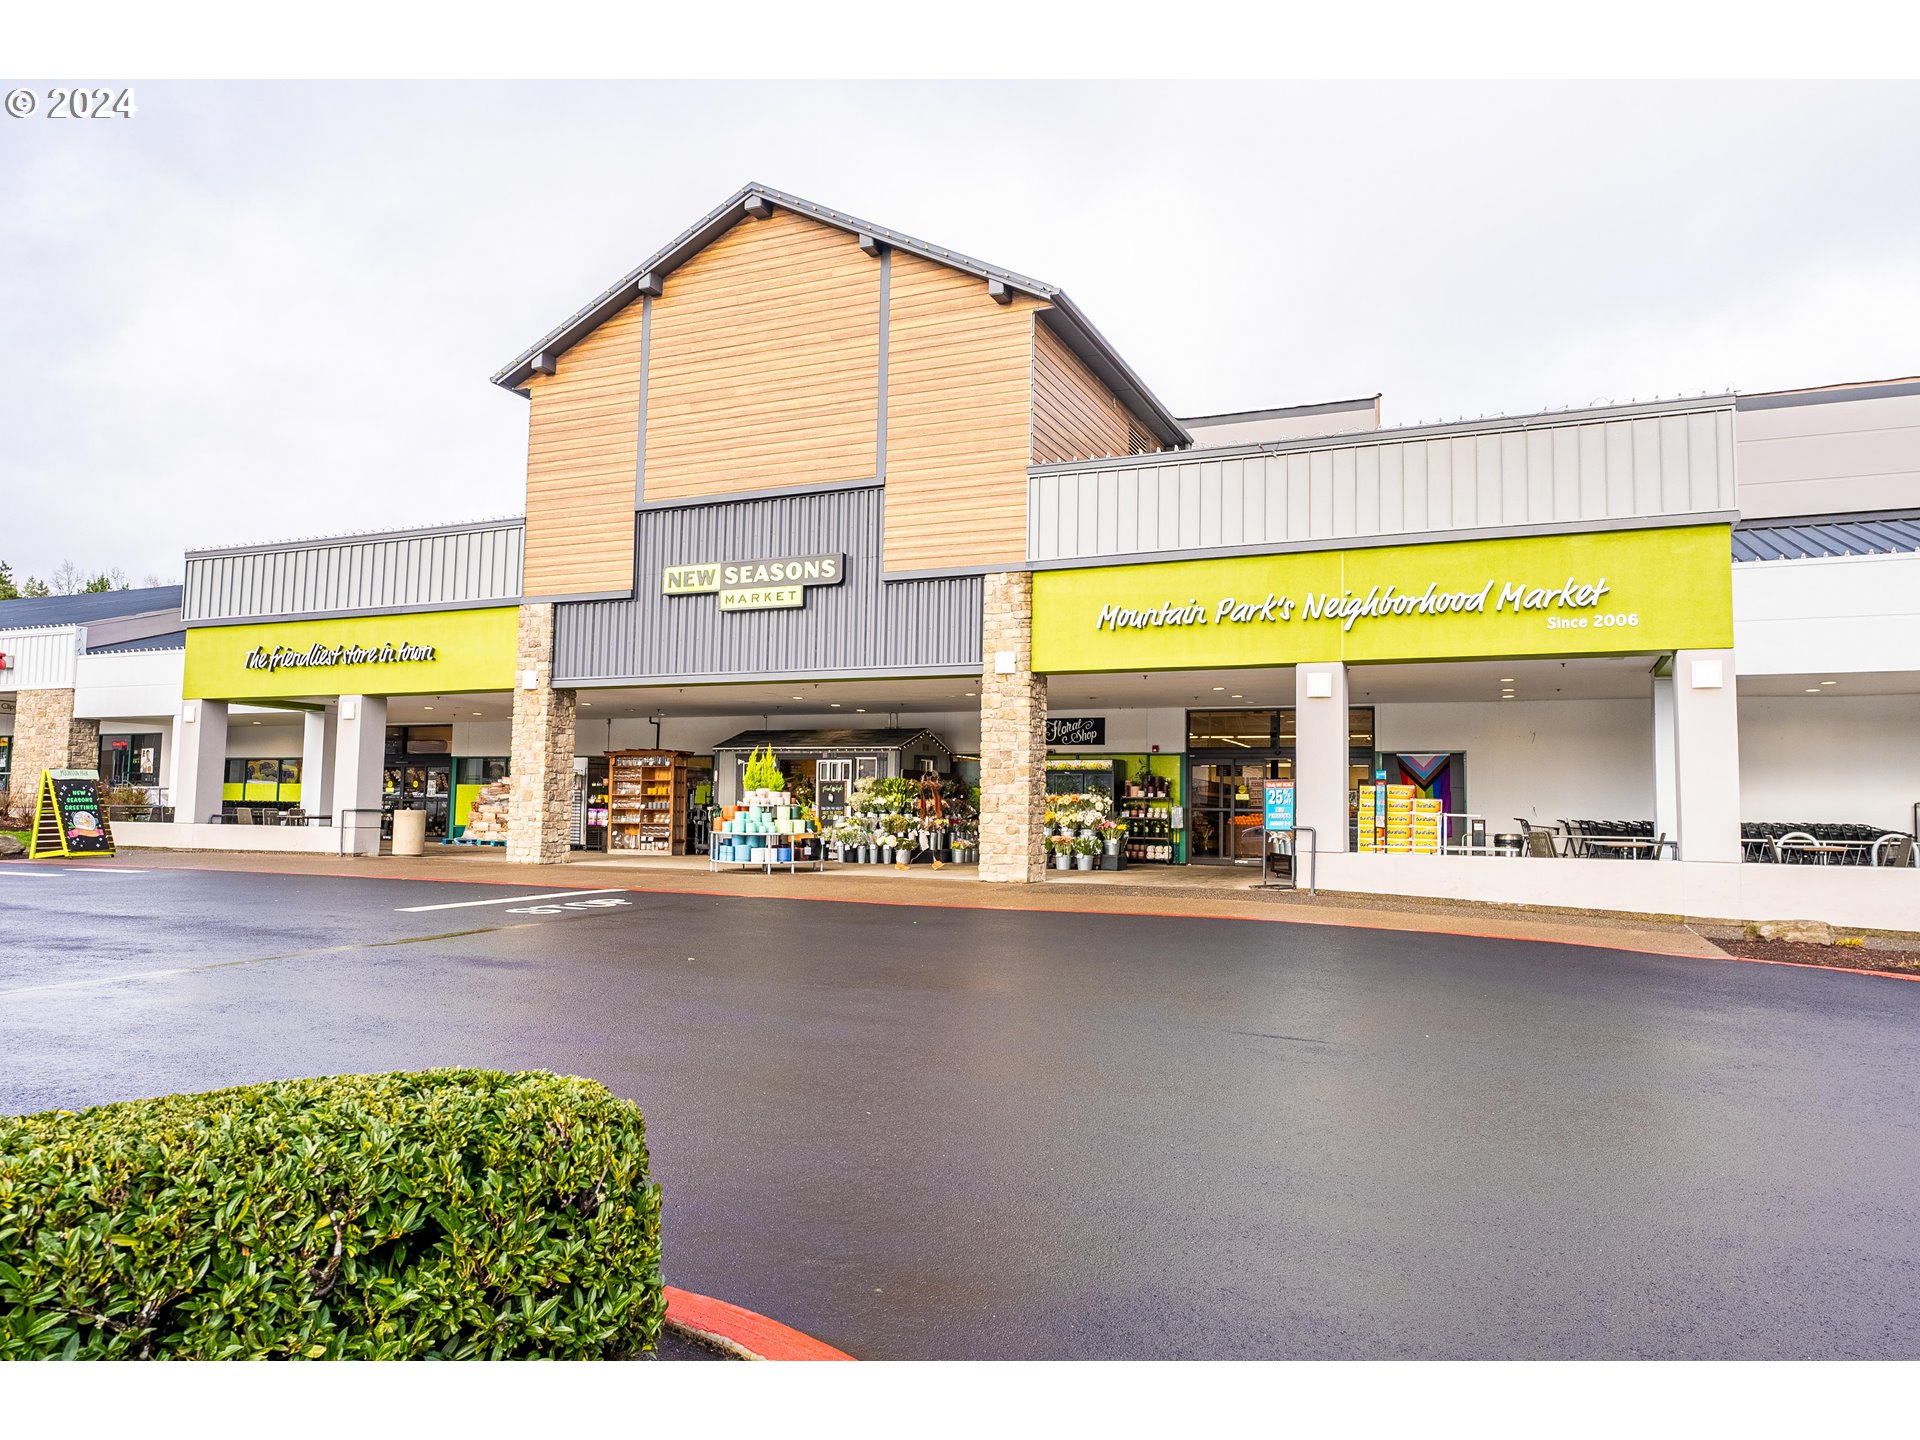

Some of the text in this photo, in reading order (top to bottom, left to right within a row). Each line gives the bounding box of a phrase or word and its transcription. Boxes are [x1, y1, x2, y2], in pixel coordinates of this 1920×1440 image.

[668, 559, 836, 588] NEW SEASONS
[725, 591, 797, 604] MARKET
[1096, 577, 1610, 631] Mountain Park's Neighborhood Market
[1547, 613, 1639, 629] Since 2006
[244, 641, 434, 673] The friendliest store in town
[1046, 719, 1094, 742] Floral
[1062, 729, 1097, 744] Shop
